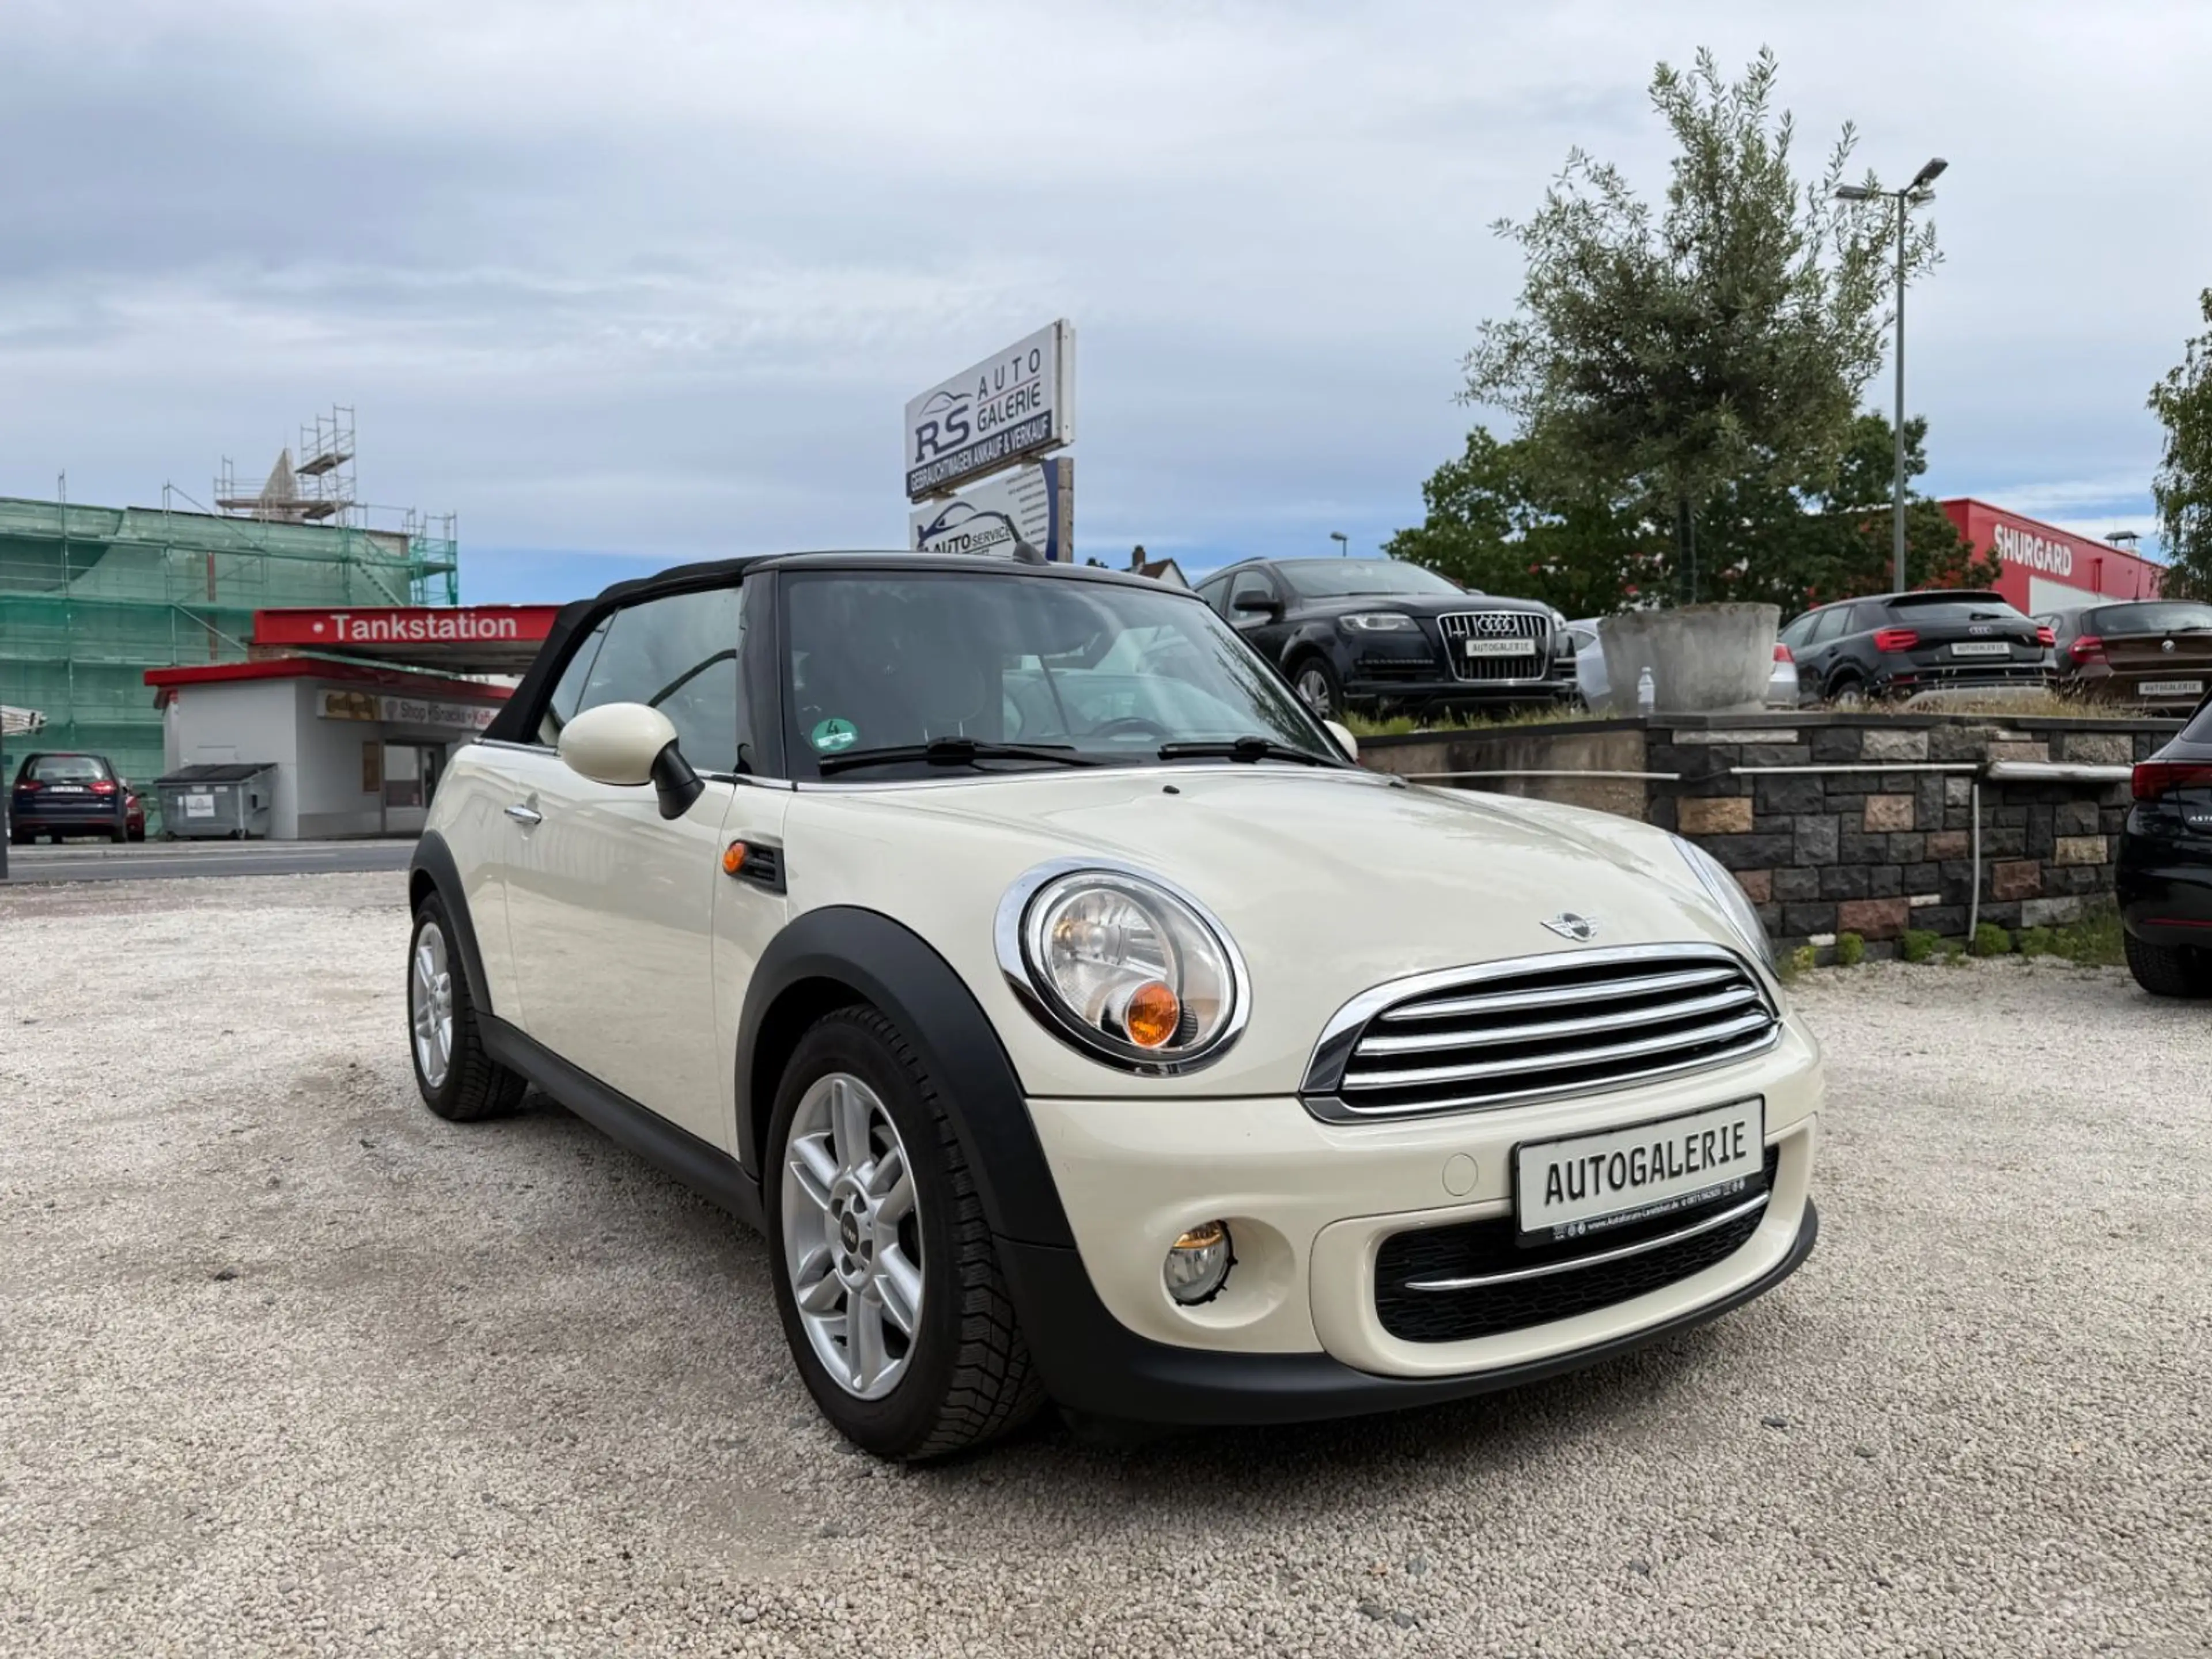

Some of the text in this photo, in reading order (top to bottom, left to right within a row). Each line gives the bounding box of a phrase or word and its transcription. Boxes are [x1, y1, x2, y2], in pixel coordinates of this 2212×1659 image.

[977, 348, 1040, 402] AUTO
[977, 382, 1040, 433] GALERIE
[915, 404, 969, 464] RS
[1994, 524, 2072, 577] SHURGARD
[329, 613, 517, 641] Tankstation
[1472, 642, 1530, 653] AUTOGALERIE
[400, 700, 426, 722] Shop
[827, 719, 839, 734] 4
[1544, 1121, 1747, 1206] AUTOGALERIE
